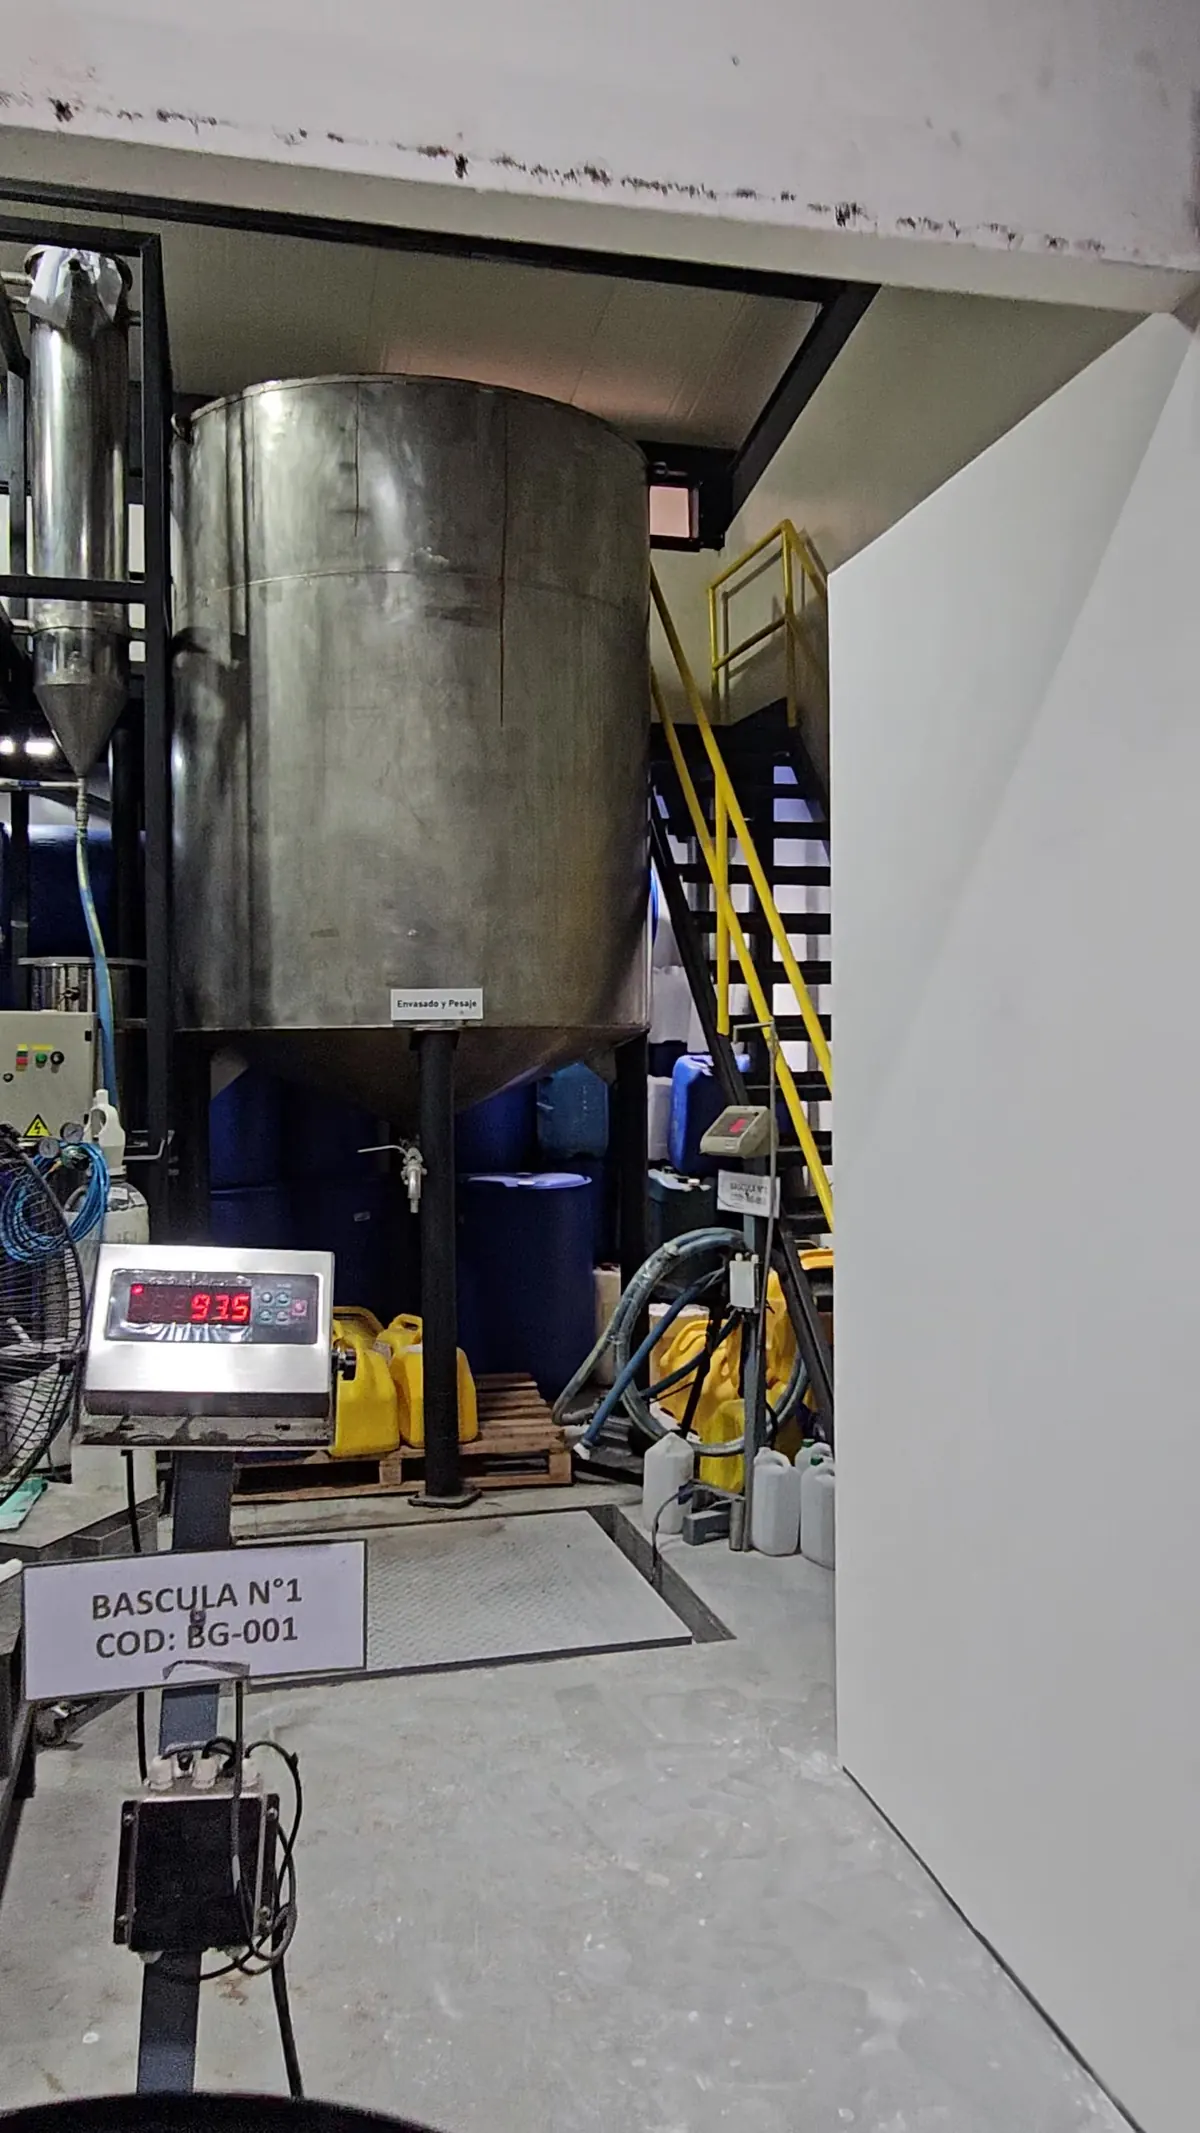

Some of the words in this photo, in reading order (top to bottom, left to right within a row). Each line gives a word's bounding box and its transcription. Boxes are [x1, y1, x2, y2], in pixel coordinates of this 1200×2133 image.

[397, 1000, 439, 1008] Envasado
[441, 1001, 447, 1009] y
[449, 999, 477, 1009] Pesaje
[92, 1585, 238, 1621] BASCULA
[249, 1577, 302, 1606] N°1
[96, 1629, 176, 1659] COD:
[187, 1616, 298, 1650] BG-001
